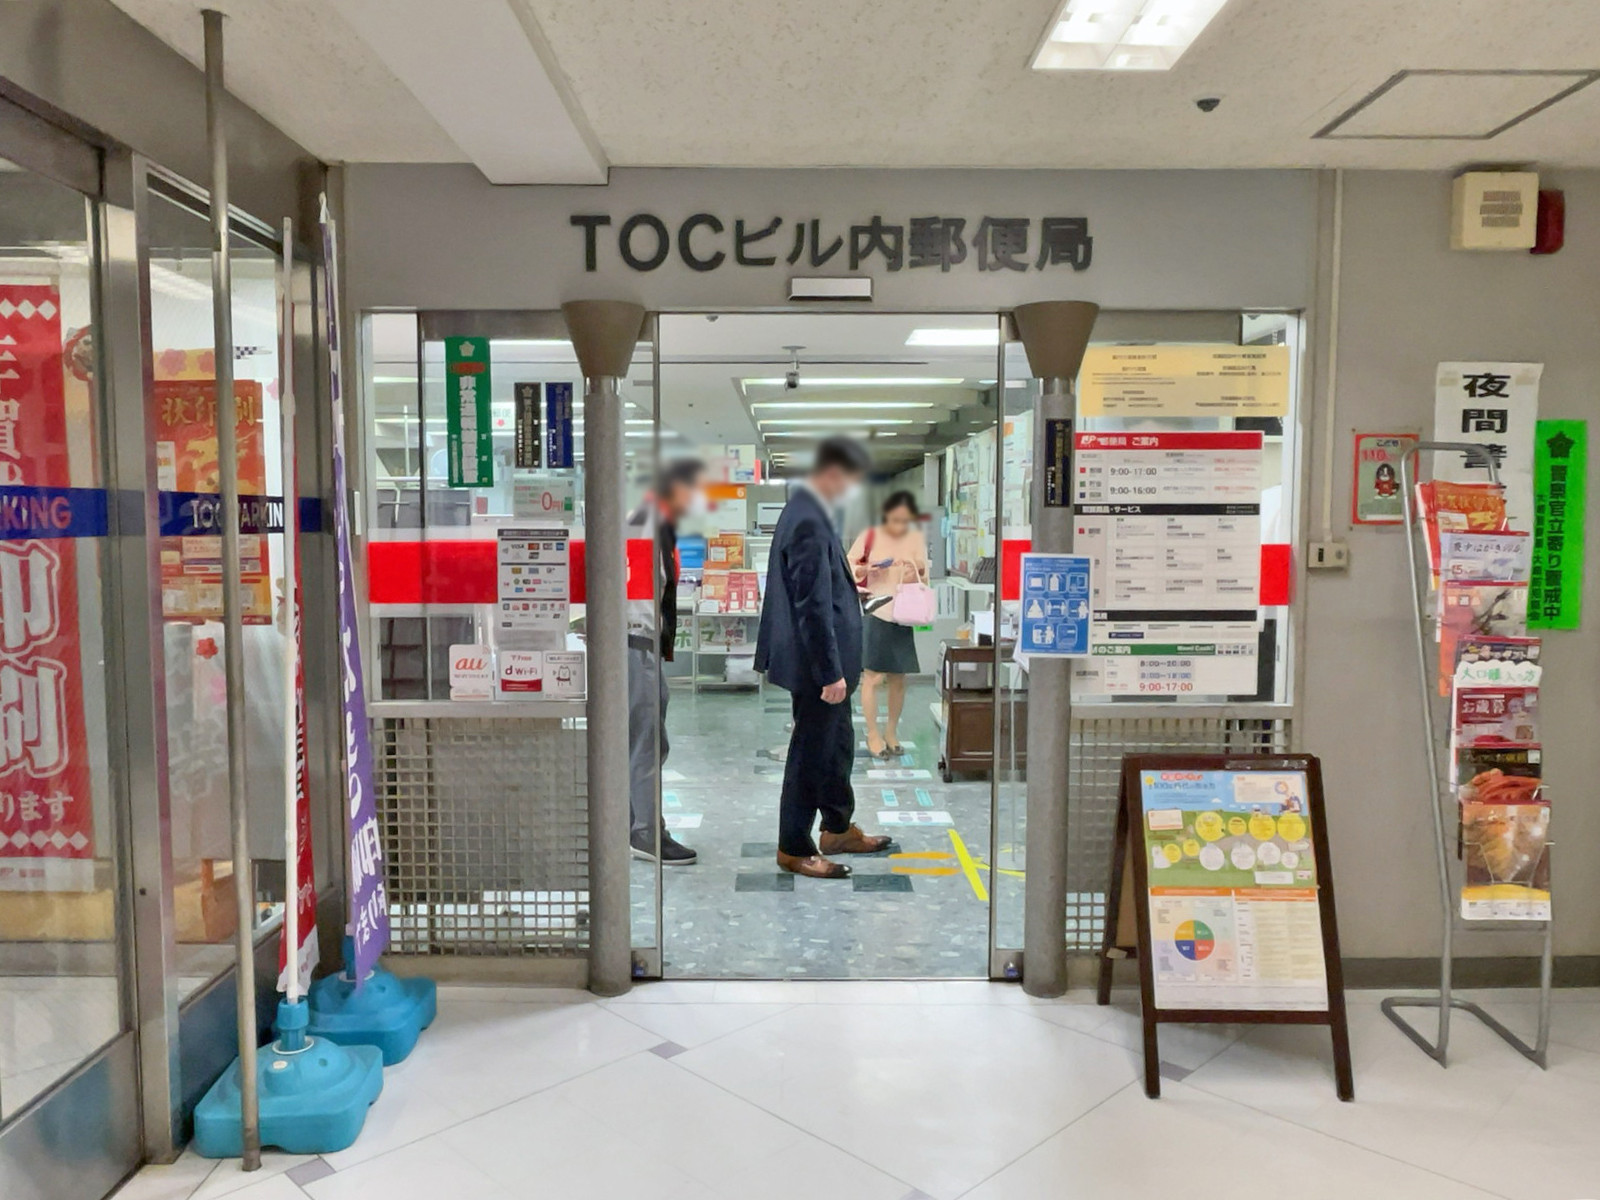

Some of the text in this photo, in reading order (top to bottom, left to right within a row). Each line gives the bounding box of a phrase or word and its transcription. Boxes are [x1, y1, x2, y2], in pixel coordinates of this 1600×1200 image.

[570, 213, 1093, 272] TOCビル内郵便局
